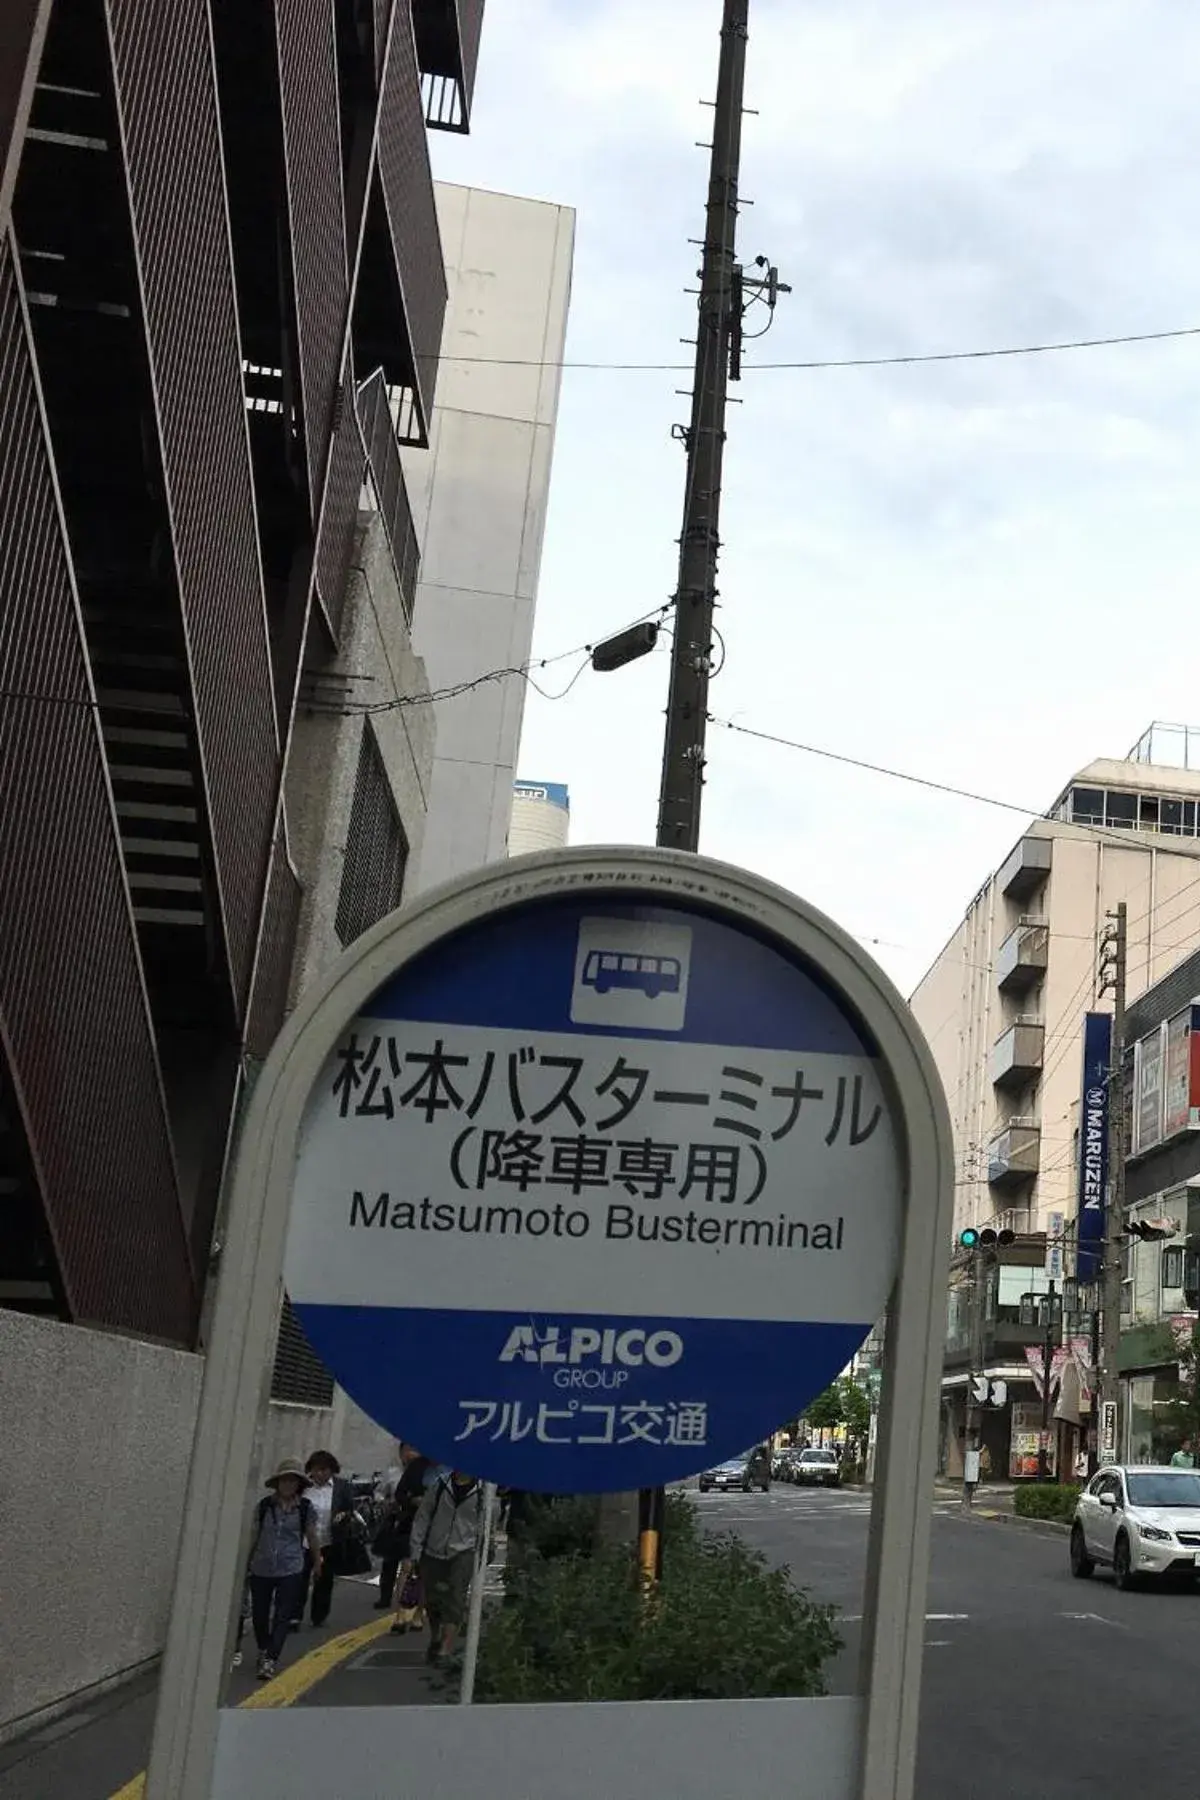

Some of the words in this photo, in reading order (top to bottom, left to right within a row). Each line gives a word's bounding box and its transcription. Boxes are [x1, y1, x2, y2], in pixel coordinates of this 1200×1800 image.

[331, 1032, 882, 1147] 松本バスターミナル
[448, 1127, 768, 1205] （降車専用）
[1084, 1110, 1103, 1210] MARUZEN
[348, 1191, 591, 1239] Matsumoto
[605, 1204, 845, 1251] Busterminal
[498, 1324, 684, 1368] ALPICO
[553, 1367, 629, 1389] GROUP
[454, 1399, 707, 1446] アルピコ交通
